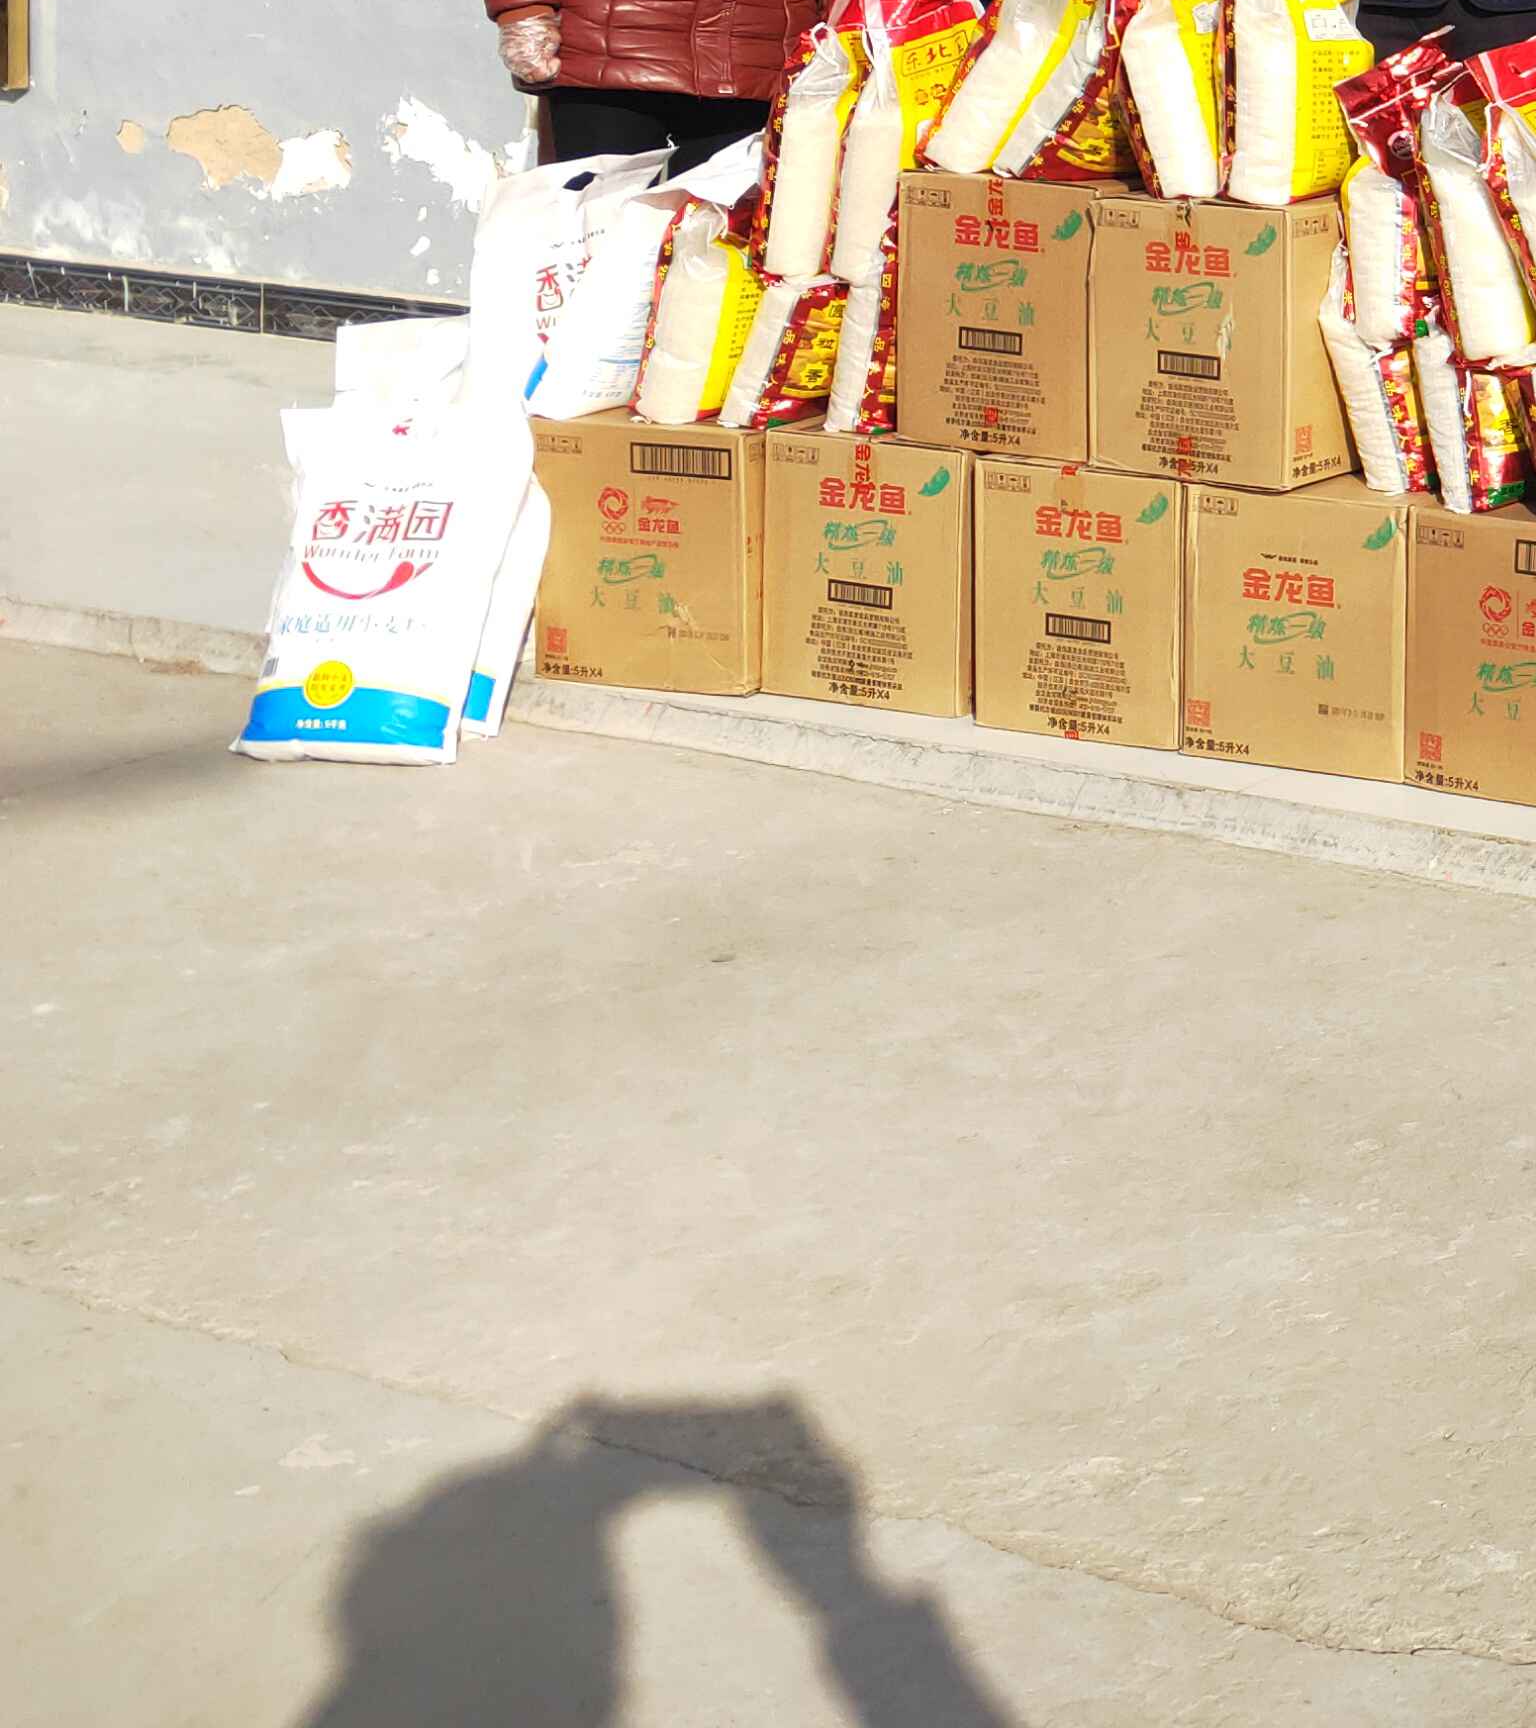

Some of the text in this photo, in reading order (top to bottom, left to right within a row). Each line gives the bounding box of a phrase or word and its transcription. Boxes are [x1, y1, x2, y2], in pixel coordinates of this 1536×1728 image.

[954, 214, 1041, 254] 金龙鱼
[1144, 239, 1232, 278] 金龙鱼
[818, 476, 907, 516] 金龙鱼
[311, 500, 454, 546] 香满园
[637, 517, 682, 535] 金龙鱼
[1035, 504, 1124, 544] 金龙鱼
[1241, 567, 1336, 609] 金龙鱼
